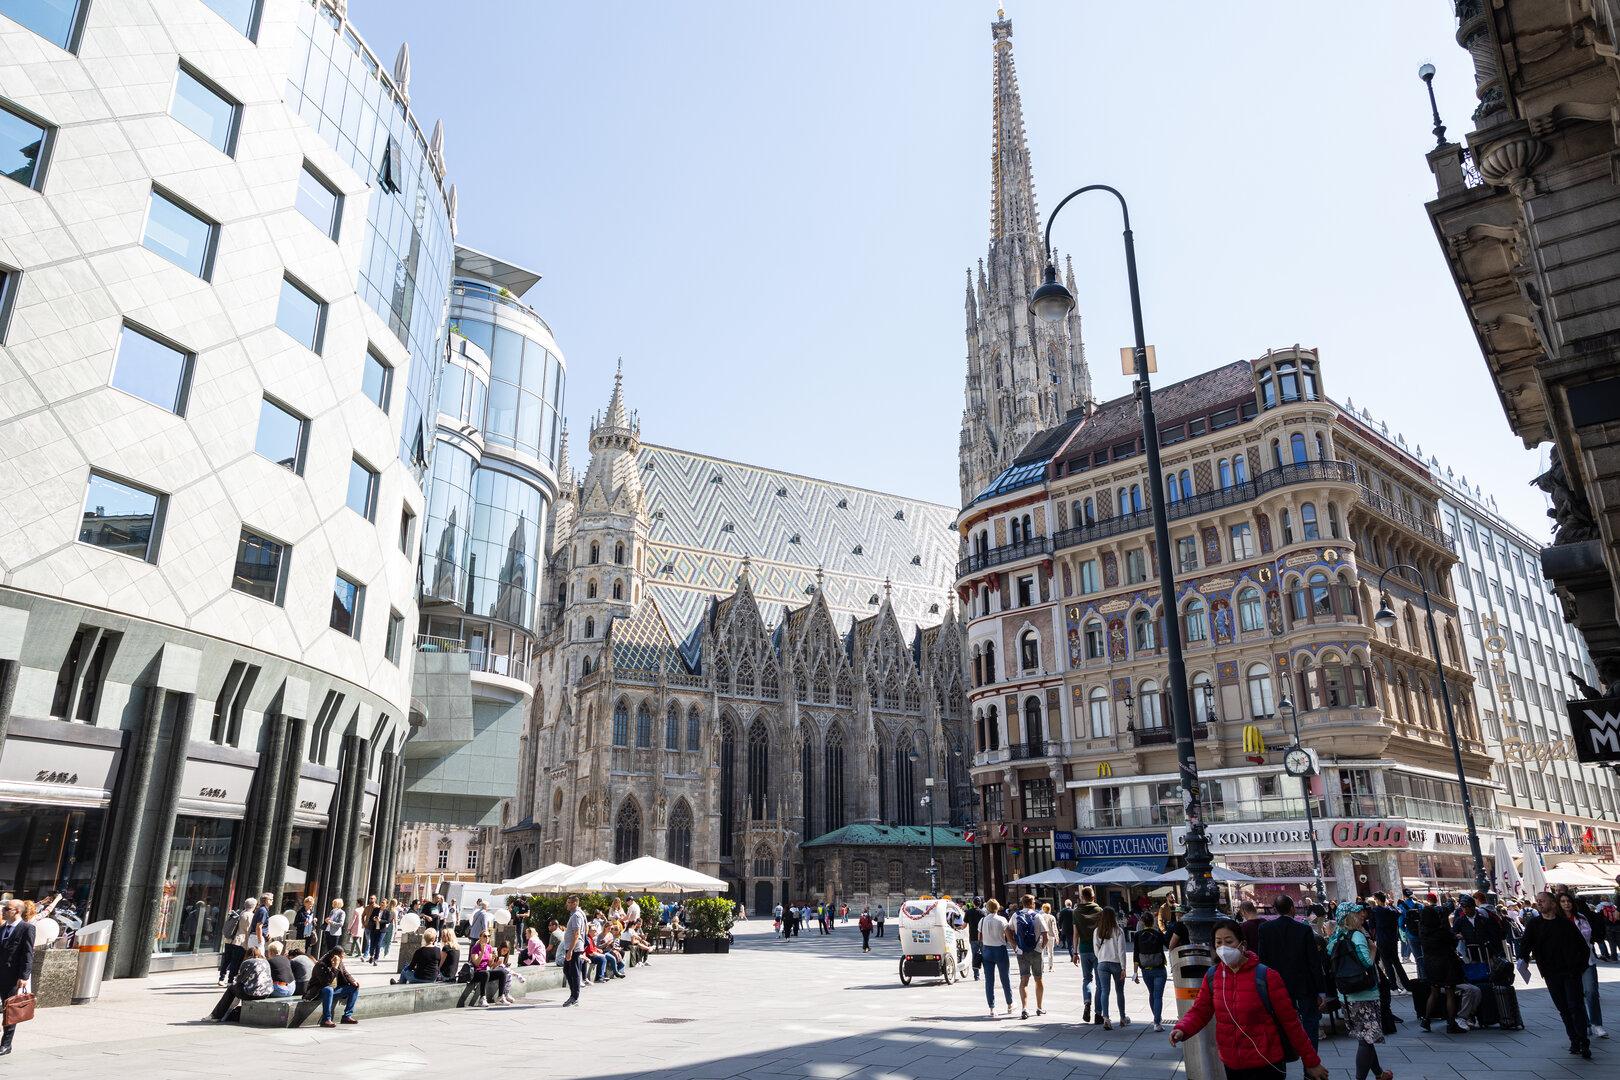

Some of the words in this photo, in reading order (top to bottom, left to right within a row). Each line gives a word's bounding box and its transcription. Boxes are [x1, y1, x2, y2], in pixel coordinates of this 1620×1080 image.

[1481, 611, 1519, 727] HOTEL
[1589, 726, 1620, 754] M
[1054, 842, 1074, 850] CHANGE
[1076, 839, 1110, 855] MONEY
[1113, 837, 1168, 854] EXCHANGE
[1217, 829, 1319, 845] KONDITOREI
